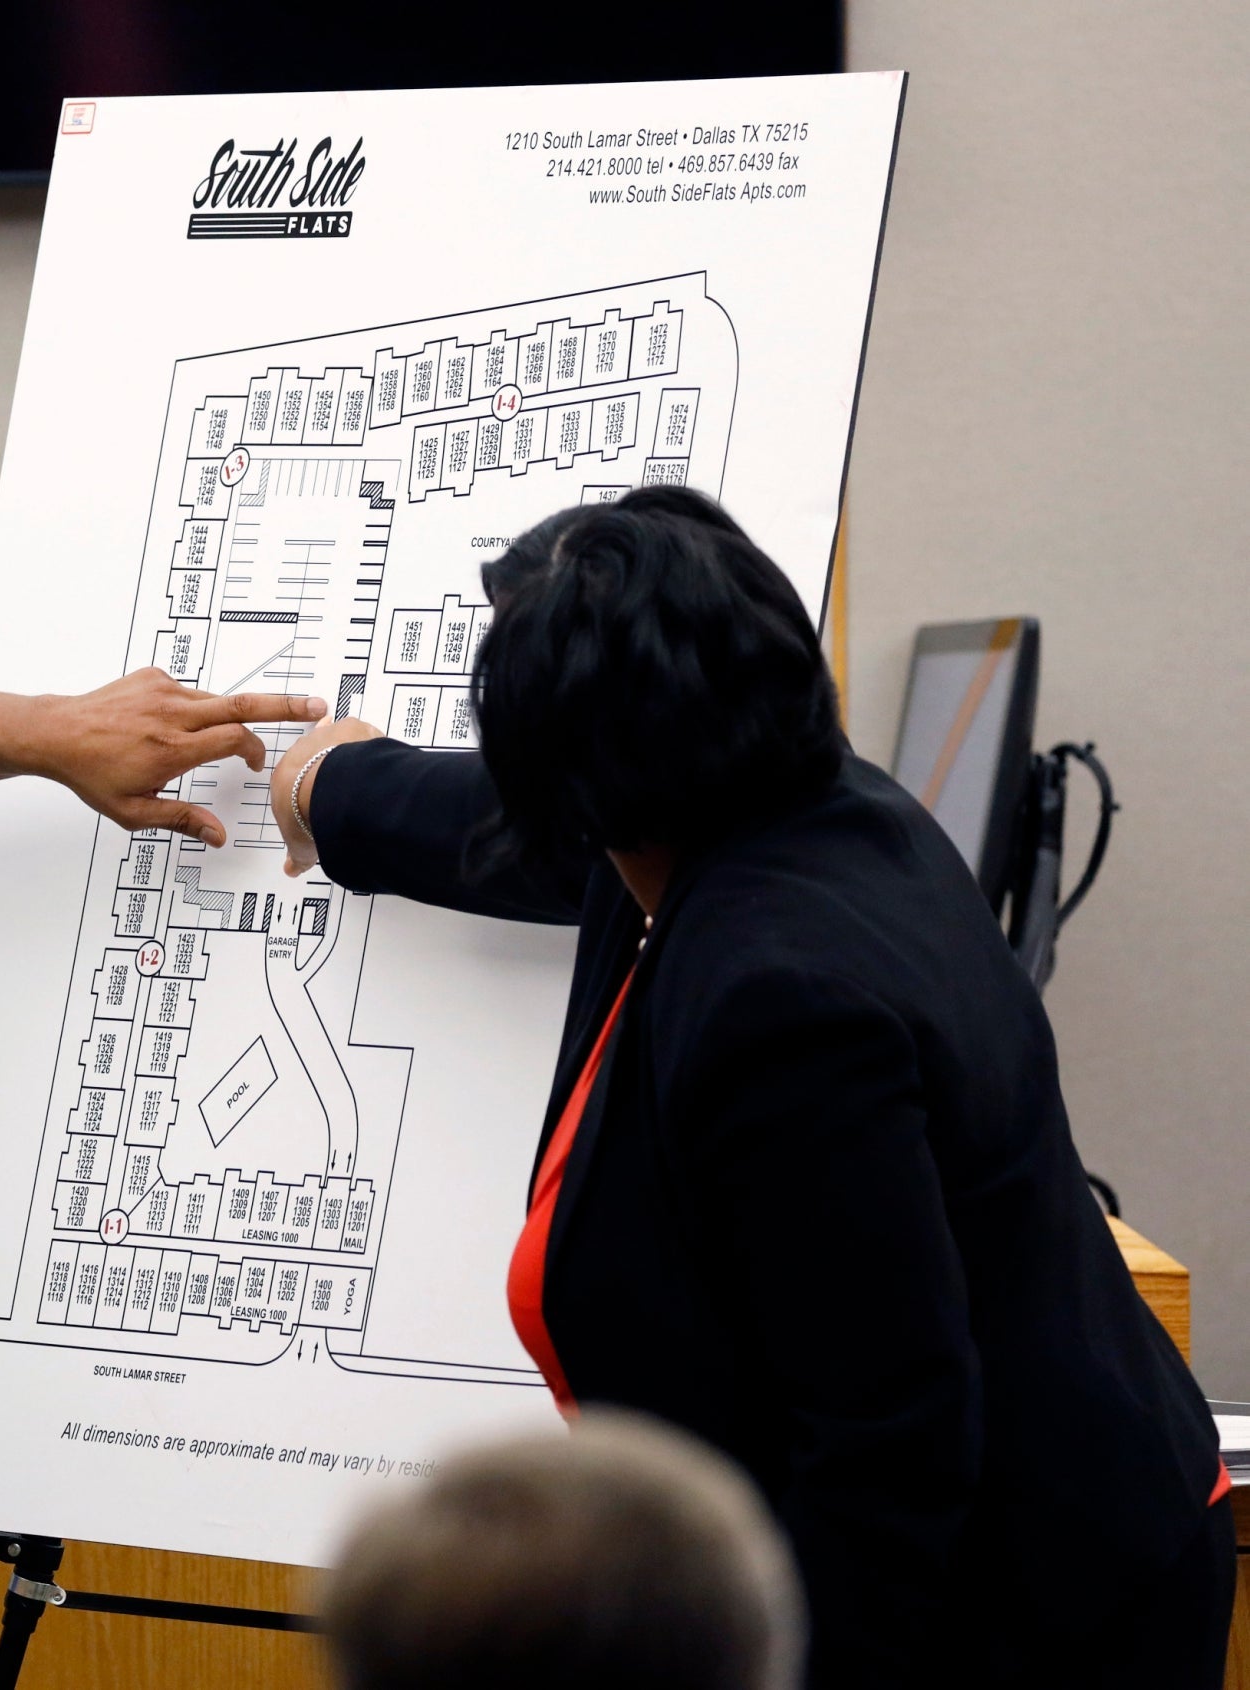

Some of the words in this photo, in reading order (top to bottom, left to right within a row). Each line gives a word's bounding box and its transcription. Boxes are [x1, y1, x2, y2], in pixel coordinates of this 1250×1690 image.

[505, 132, 538, 150] 1210
[543, 131, 582, 149] South
[588, 130, 632, 148] Lamar
[636, 128, 678, 146] Street
[693, 126, 736, 144] Dallas
[742, 124, 760, 142] TX
[765, 123, 808, 141] 75215
[546, 157, 642, 176] 214.421.8000
[647, 156, 664, 174] tel
[678, 152, 774, 173] 469.857.6439
[778, 152, 799, 170] fax
[193, 137, 298, 209] South
[290, 136, 366, 208] Side
[589, 185, 666, 204] www.South
[671, 183, 736, 201] SideFlats
[740, 182, 806, 204] Apts.com
[287, 216, 348, 234] FLATS
[650, 323, 668, 335] 1472
[599, 330, 617, 342] 1470
[649, 334, 667, 346] 1372
[527, 341, 545, 354] 1466
[598, 340, 616, 352] 1370
[648, 344, 666, 356] 1272
[448, 356, 466, 368] 1462
[526, 352, 544, 364] 1366
[596, 351, 615, 363] 1270
[646, 354, 664, 367] 1172
[446, 366, 465, 379] 1362
[525, 362, 543, 374] 1266
[596, 361, 614, 374] 1170
[381, 369, 398, 381] 1458
[524, 372, 542, 385] 1166
[380, 379, 398, 391] 1358
[446, 377, 464, 389] 1262
[254, 390, 272, 400] 1450
[316, 390, 334, 400] 1454
[379, 390, 396, 402] 1258
[444, 387, 462, 399] 1162
[252, 400, 270, 411] 1350
[315, 400, 332, 411] 1354
[378, 400, 395, 412] 1158
[607, 402, 626, 414] 1435
[671, 404, 689, 414] 1474
[251, 410, 268, 421] 1250
[313, 410, 330, 421] 1254
[606, 412, 625, 424] 1335
[669, 414, 687, 425] 1374
[249, 420, 266, 431] 1150
[312, 420, 329, 431] 1154
[516, 417, 534, 429] 1431
[605, 422, 624, 435] 1235
[515, 428, 533, 440] 1331
[668, 424, 685, 436] 1274
[420, 437, 438, 449] 1425
[514, 438, 532, 450] 1231
[604, 433, 622, 445] 1135
[666, 435, 683, 446] 1174
[419, 447, 437, 459] 1325
[513, 448, 530, 460] 1131
[418, 458, 436, 469] 1225
[201, 465, 219, 476] 1446
[417, 468, 435, 480] 1125
[200, 475, 217, 486] 1346
[198, 486, 215, 496] 1246
[196, 496, 213, 507] 1146
[192, 526, 208, 535] 1444
[190, 535, 207, 546] 1344
[188, 545, 205, 556] 1244
[187, 556, 203, 565] 1144
[406, 621, 423, 632] 1451
[448, 622, 466, 632] 1449
[174, 634, 192, 645] 1440
[404, 631, 421, 642] 1351
[446, 632, 464, 643] 1349
[172, 644, 190, 654] 1340
[402, 641, 420, 652] 1251
[444, 642, 462, 653] 1249
[171, 654, 188, 665] 1240
[400, 652, 418, 662] 1151
[443, 653, 460, 663] 1149
[169, 665, 186, 675] 1140
[138, 844, 155, 855] 1432
[136, 854, 154, 865] 1332
[134, 864, 152, 875] 1232
[133, 874, 150, 885] 1132
[178, 933, 196, 944] 1423
[267, 936, 298, 946] GARAGE
[177, 943, 194, 954] 1323
[269, 949, 292, 959] ENTRY
[175, 953, 192, 964] 1223
[173, 963, 190, 974] 1123
[99, 1033, 116, 1044] 1426
[155, 1032, 172, 1042] 1419
[98, 1043, 114, 1054] 1326
[153, 1041, 171, 1052] 1319
[96, 1054, 113, 1064] 1226
[152, 1052, 169, 1063] 1219
[94, 1064, 111, 1074] 1126
[150, 1062, 166, 1072] 1119
[227, 1082, 250, 1109] POOL
[80, 1139, 98, 1150] 1422
[79, 1148, 96, 1160] 1322
[77, 1159, 94, 1170] 1222
[75, 1169, 92, 1180] 1122
[189, 1193, 205, 1204] 1411
[262, 1190, 280, 1201] 1407
[187, 1203, 204, 1214] 1311
[260, 1200, 278, 1212] 1307
[351, 1200, 368, 1211] 1401
[185, 1213, 202, 1224] 1211
[258, 1210, 276, 1222] 1207
[349, 1210, 367, 1222] 1301
[183, 1224, 199, 1234] 1111
[348, 1220, 365, 1232] 1201
[242, 1229, 278, 1241] LEASING
[281, 1232, 298, 1243] 1000
[344, 1238, 364, 1248] MAIL
[53, 1261, 70, 1272] 1418
[110, 1266, 127, 1277] 1414
[51, 1271, 68, 1283] 1318
[108, 1276, 125, 1287] 1314
[191, 1274, 209, 1285] 1408
[49, 1282, 66, 1293] 1218
[106, 1286, 123, 1298] 1214
[190, 1283, 208, 1295] 1308
[47, 1292, 64, 1302] 1118
[188, 1294, 206, 1305] 1208
[344, 1277, 357, 1315] YOGA
[104, 1296, 120, 1308] 1114
[230, 1306, 266, 1319] LEASING
[269, 1310, 287, 1320] 1000
[94, 1365, 122, 1377] SOUTH
[123, 1368, 152, 1381] LAMAR
[154, 1371, 186, 1384] STREET
[61, 1422, 81, 1440] All
[83, 1424, 160, 1449] dimensions
[163, 1435, 185, 1452] are
[189, 1438, 274, 1461] approximate
[278, 1446, 307, 1464] and
[308, 1451, 340, 1472] may
[344, 1455, 374, 1476] vary
[377, 1454, 396, 1478] by
